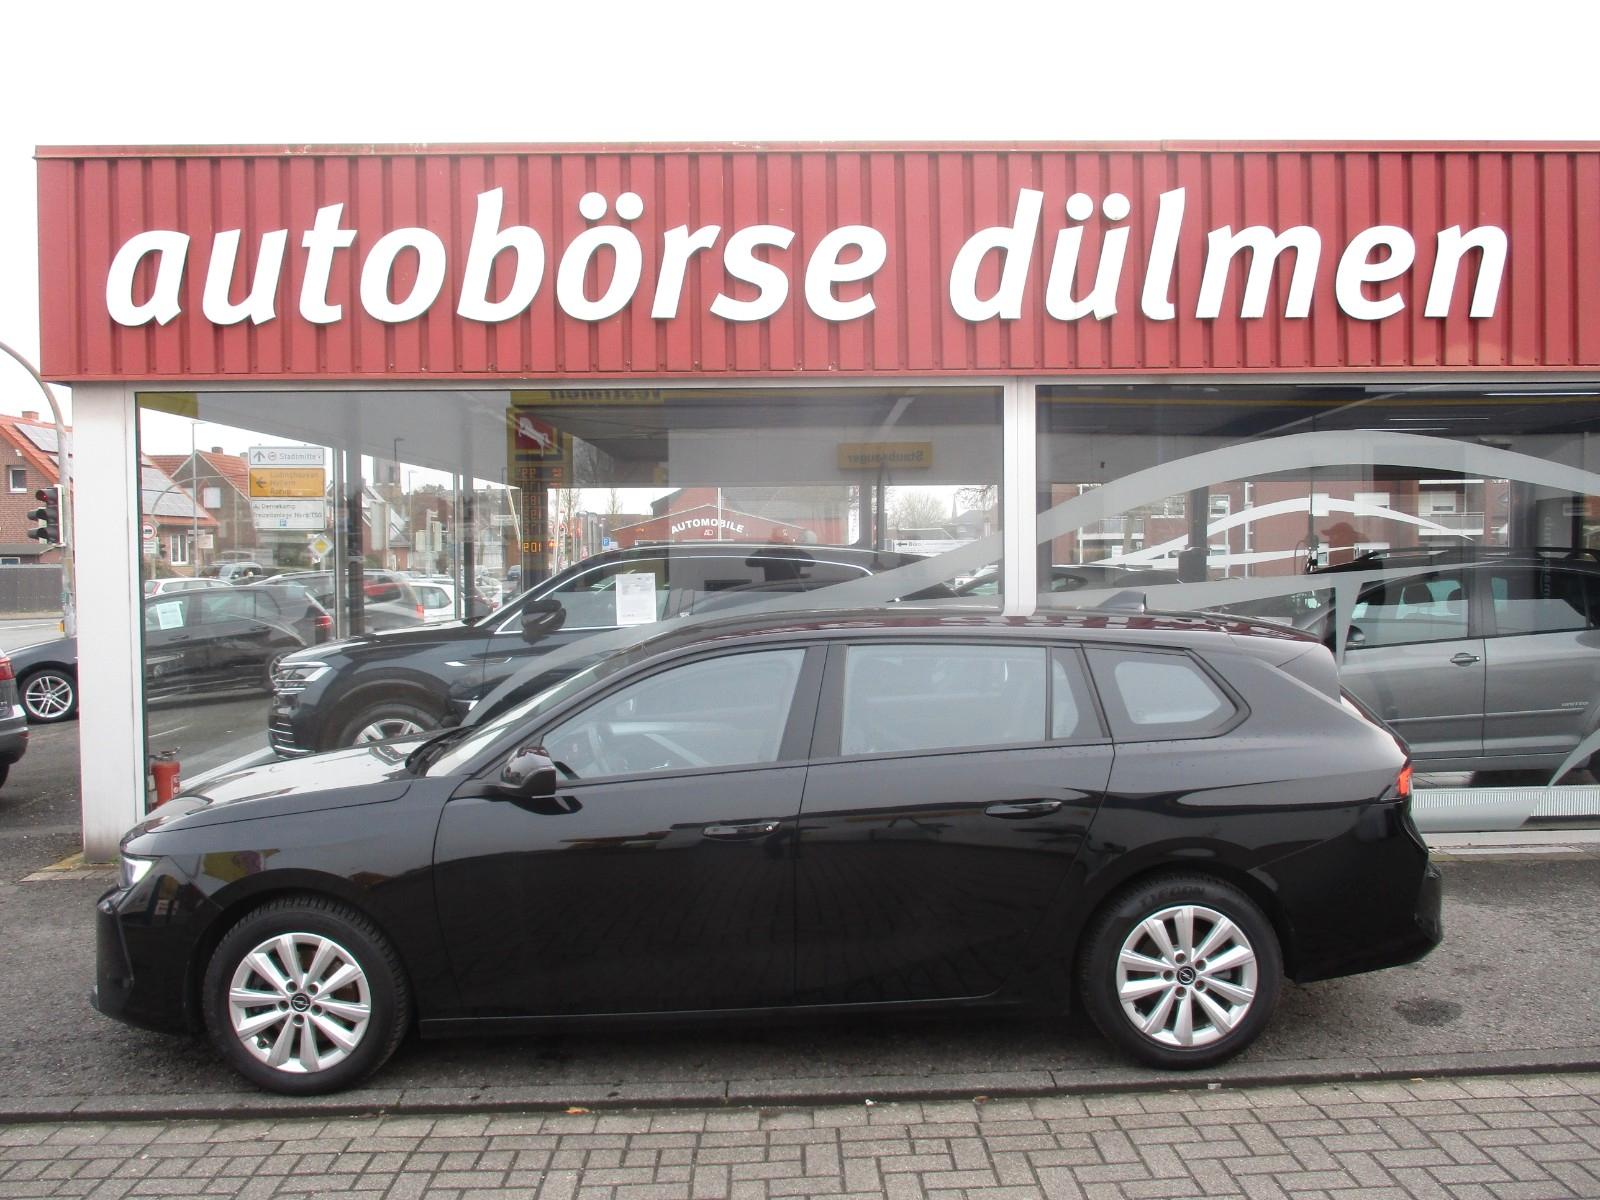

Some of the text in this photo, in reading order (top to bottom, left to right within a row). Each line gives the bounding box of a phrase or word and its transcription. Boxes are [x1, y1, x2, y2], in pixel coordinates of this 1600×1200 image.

[105, 186, 1509, 327] autobörse dülmen
[671, 518, 745, 534] AUTOMOBILE
